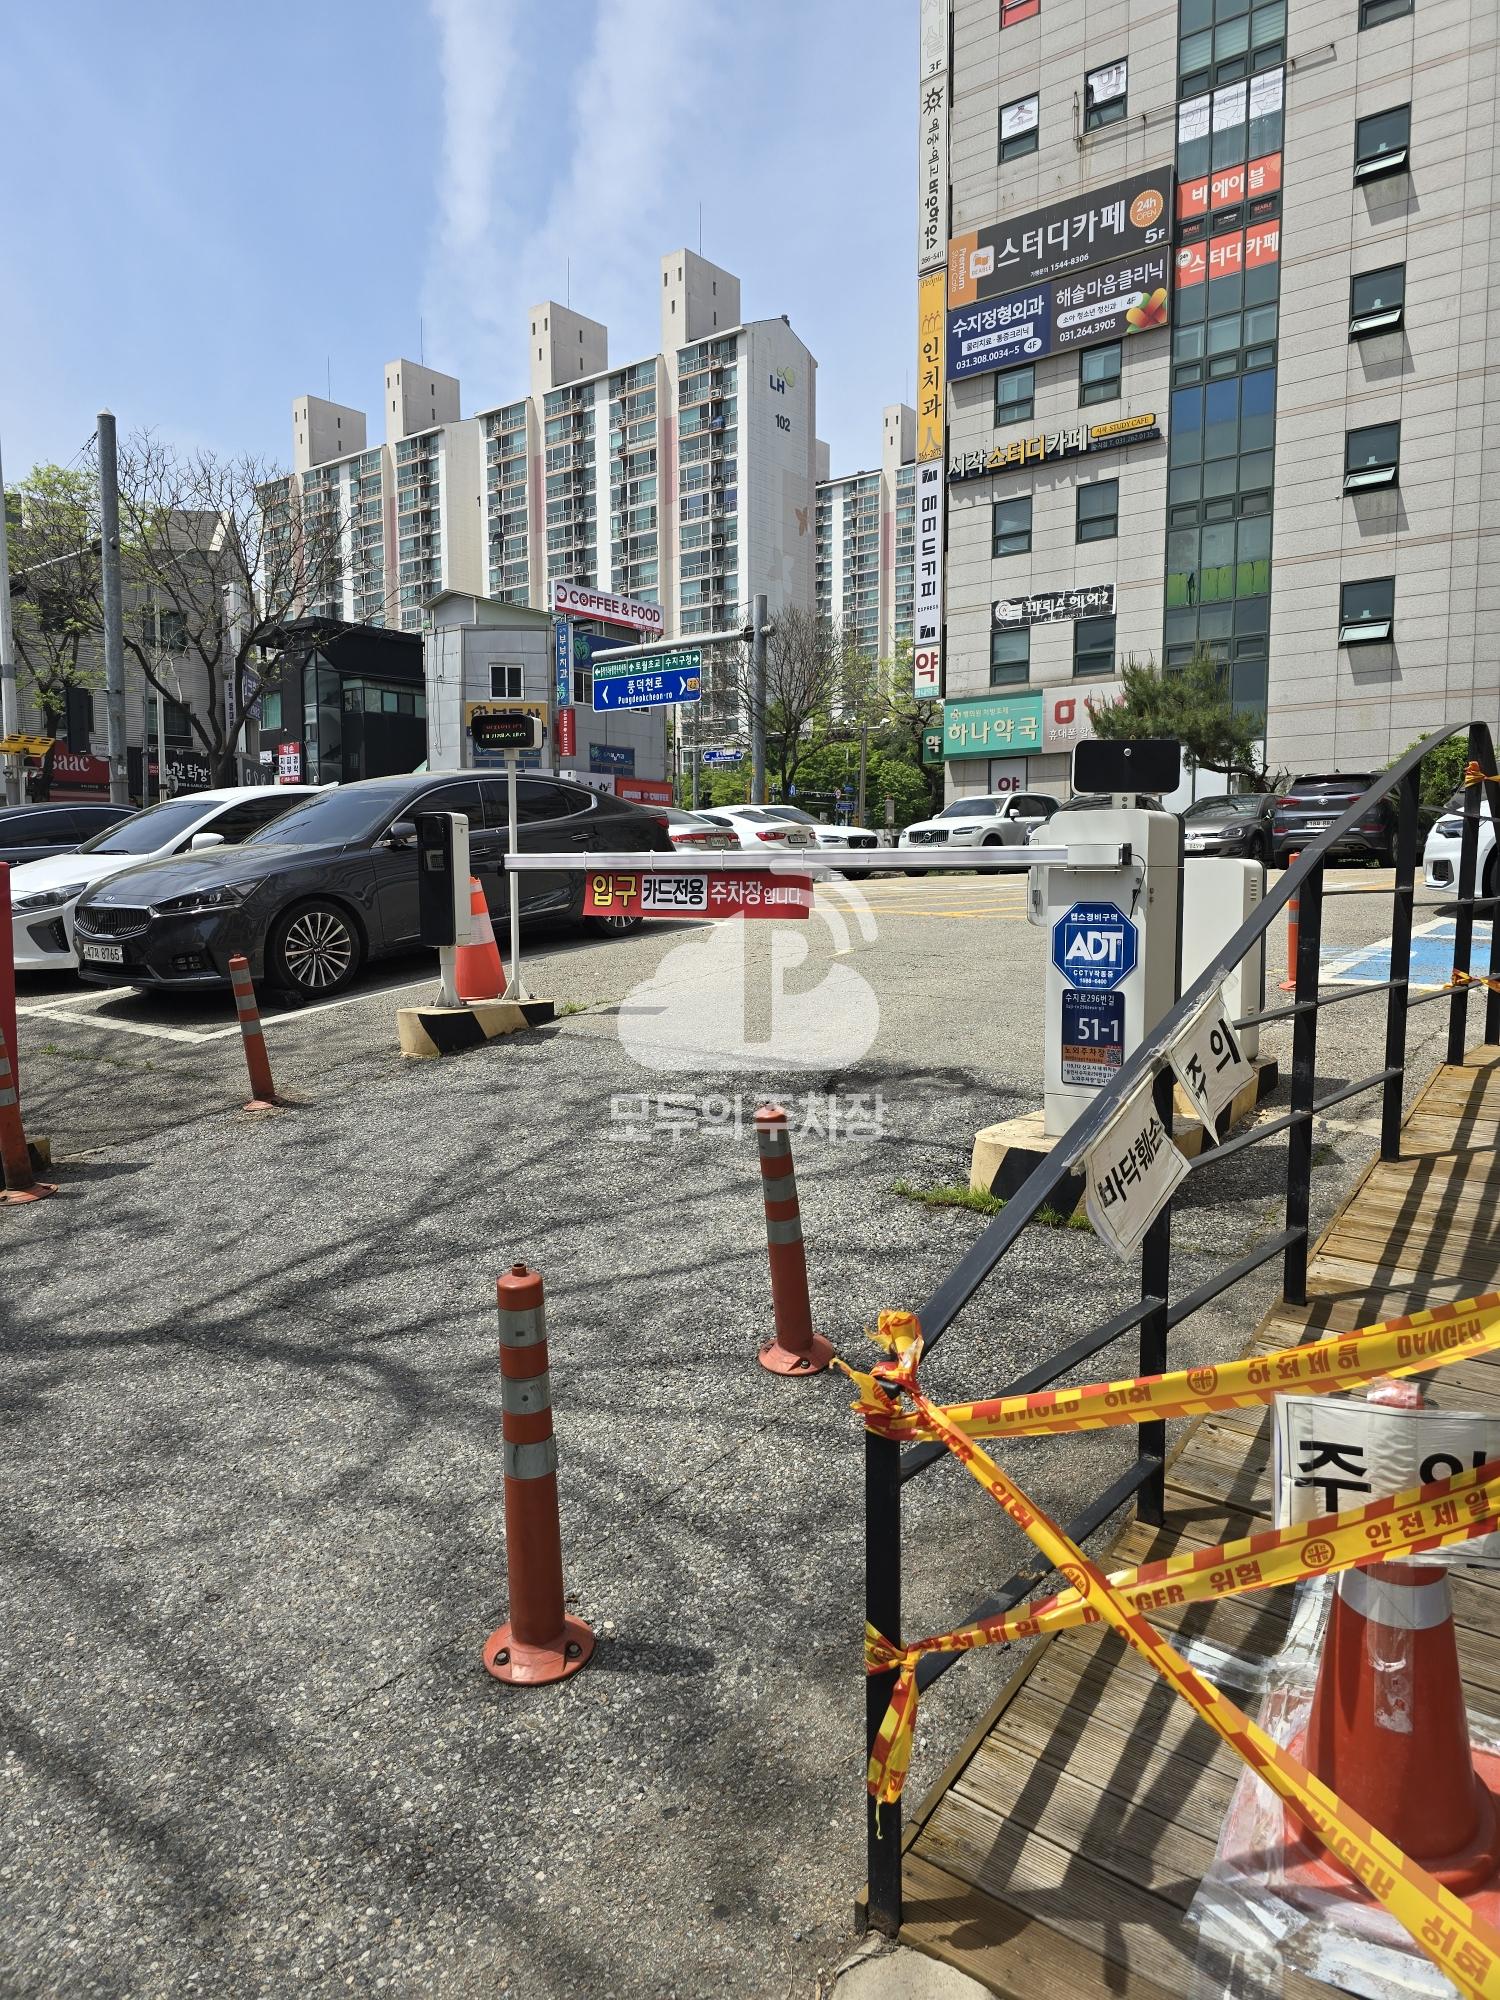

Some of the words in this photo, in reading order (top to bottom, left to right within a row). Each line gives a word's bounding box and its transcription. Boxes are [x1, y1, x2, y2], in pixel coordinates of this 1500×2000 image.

[928, 59, 942, 74] 3F
[1191, 167, 1265, 205] 비에이블
[1136, 196, 1157, 213] 24h
[1136, 208, 1157, 222] OPEN
[997, 199, 1126, 268] 스터디카페
[1144, 228, 1166, 244] 5F
[1050, 253, 1089, 272] 1544-8306
[1189, 231, 1279, 273] 스터디카페
[1056, 259, 1163, 307] 해솔마음클리닉
[952, 295, 1044, 338] 수지정형외과
[1062, 313, 1075, 324] 소아
[1076, 308, 1096, 321] 청소년
[1097, 303, 1117, 317] 정신과
[1126, 295, 1136, 305] 4F
[1059, 318, 1116, 342] 031.264.3905
[1027, 340, 1037, 350] 4F
[956, 345, 1020, 370] 031.308.0034~5
[769, 374, 785, 395] LH
[921, 336, 943, 419] 인치과
[775, 413, 791, 433] 102
[1109, 420, 1131, 432] STUDY
[1131, 416, 1149, 427] CAFE
[569, 590, 619, 614] COFFEE
[621, 602, 630, 616] &
[631, 605, 660, 623] FOOD
[917, 604, 939, 613] EXPRESS
[665, 654, 692, 667] 수지구청
[915, 651, 939, 683] 약
[627, 676, 664, 695] 풍덕천로
[948, 717, 1039, 746] 하나약국
[1048, 727, 1077, 741] 휴대폰
[926, 735, 942, 753] 약
[592, 874, 637, 907] 입구
[643, 878, 704, 905] 카드전용
[1070, 912, 1118, 922] 캡스경비구역
[1066, 931, 1123, 962] ADT
[1065, 992, 1115, 1006] 수지로296번길
[1078, 1017, 1119, 1042] 51-1
[1064, 1046, 1105, 1058] 노외주차장
[1209, 1560, 1263, 1593] 위험
